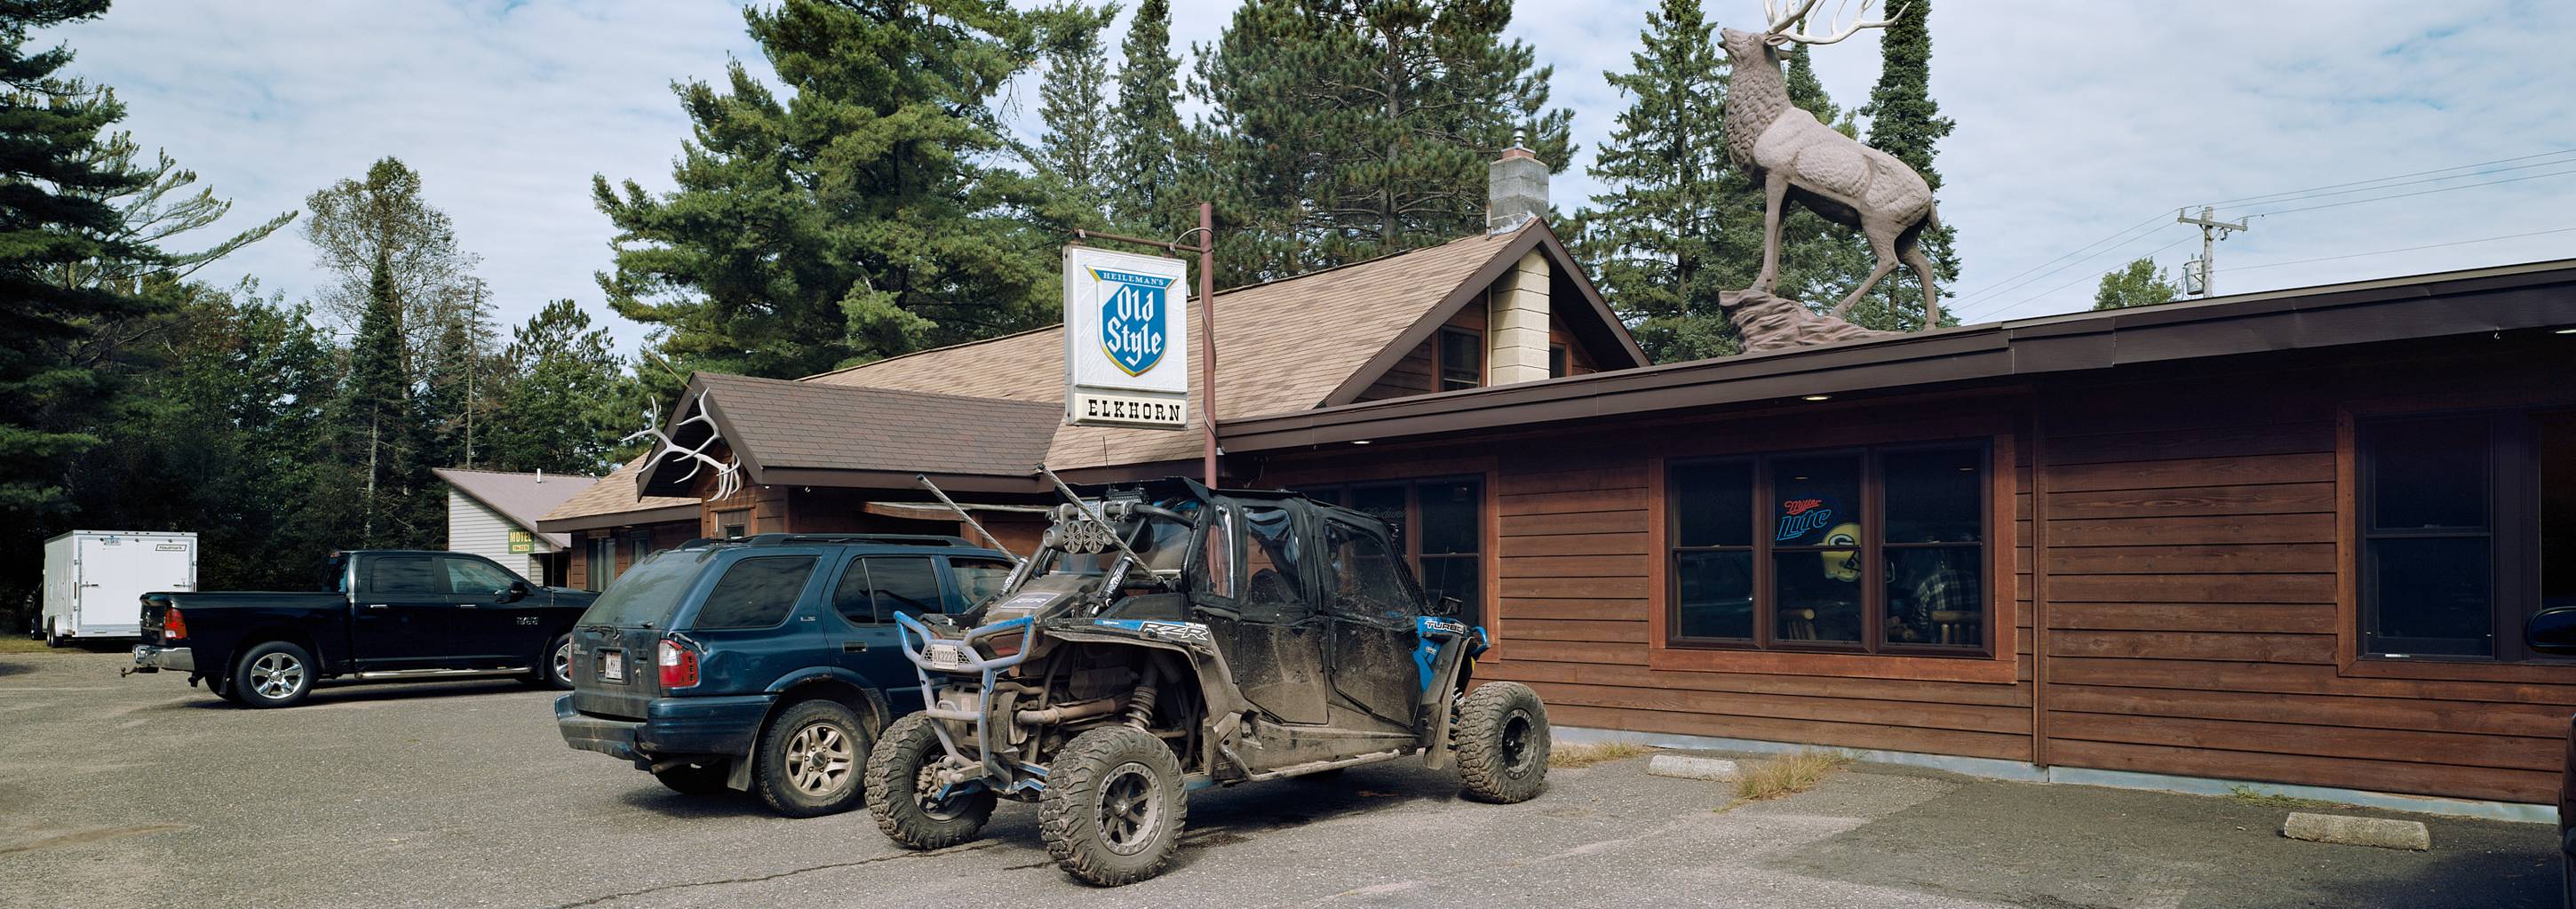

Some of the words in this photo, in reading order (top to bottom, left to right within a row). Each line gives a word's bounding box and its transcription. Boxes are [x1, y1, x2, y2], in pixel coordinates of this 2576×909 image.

[1102, 272, 1165, 285] HEILEMAN'S
[1117, 285, 1154, 322] Old
[1107, 315, 1162, 367] Style
[1088, 399, 1181, 422] ELKHORN
[1784, 498, 1822, 514] Miller
[1776, 508, 1832, 540] Lite
[509, 531, 532, 543] MOTEL
[1138, 620, 1209, 641] RZR
[1424, 620, 1465, 634] TURBO
